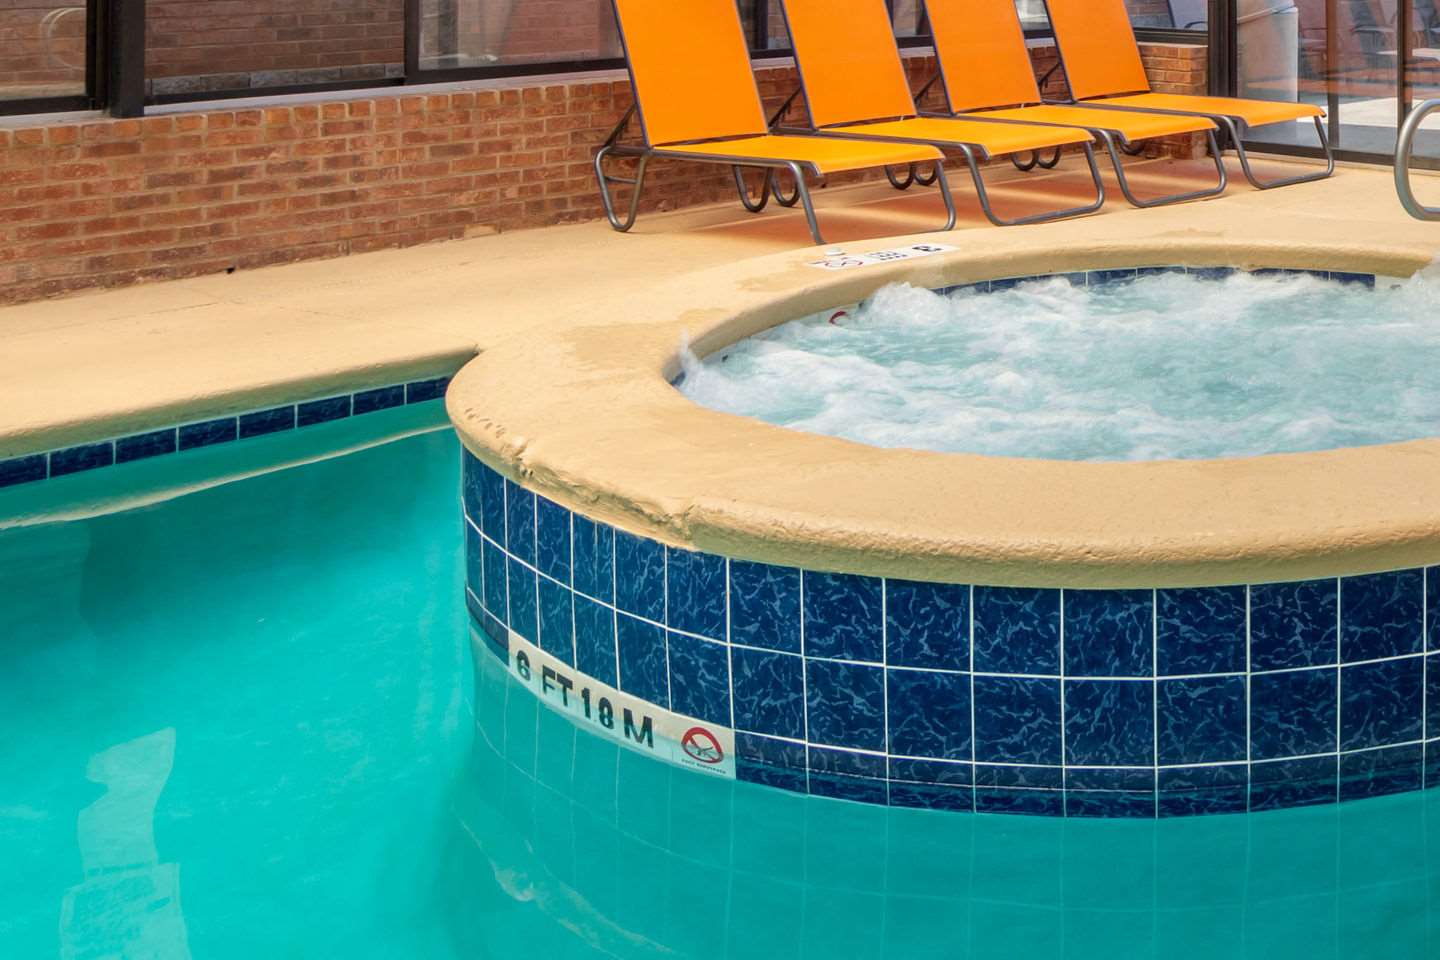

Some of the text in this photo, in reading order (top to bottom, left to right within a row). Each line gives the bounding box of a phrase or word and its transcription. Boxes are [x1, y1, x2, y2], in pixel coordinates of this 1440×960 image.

[516, 649, 531, 682] 6
[542, 664, 573, 707] FT
[623, 707, 654, 748] M
